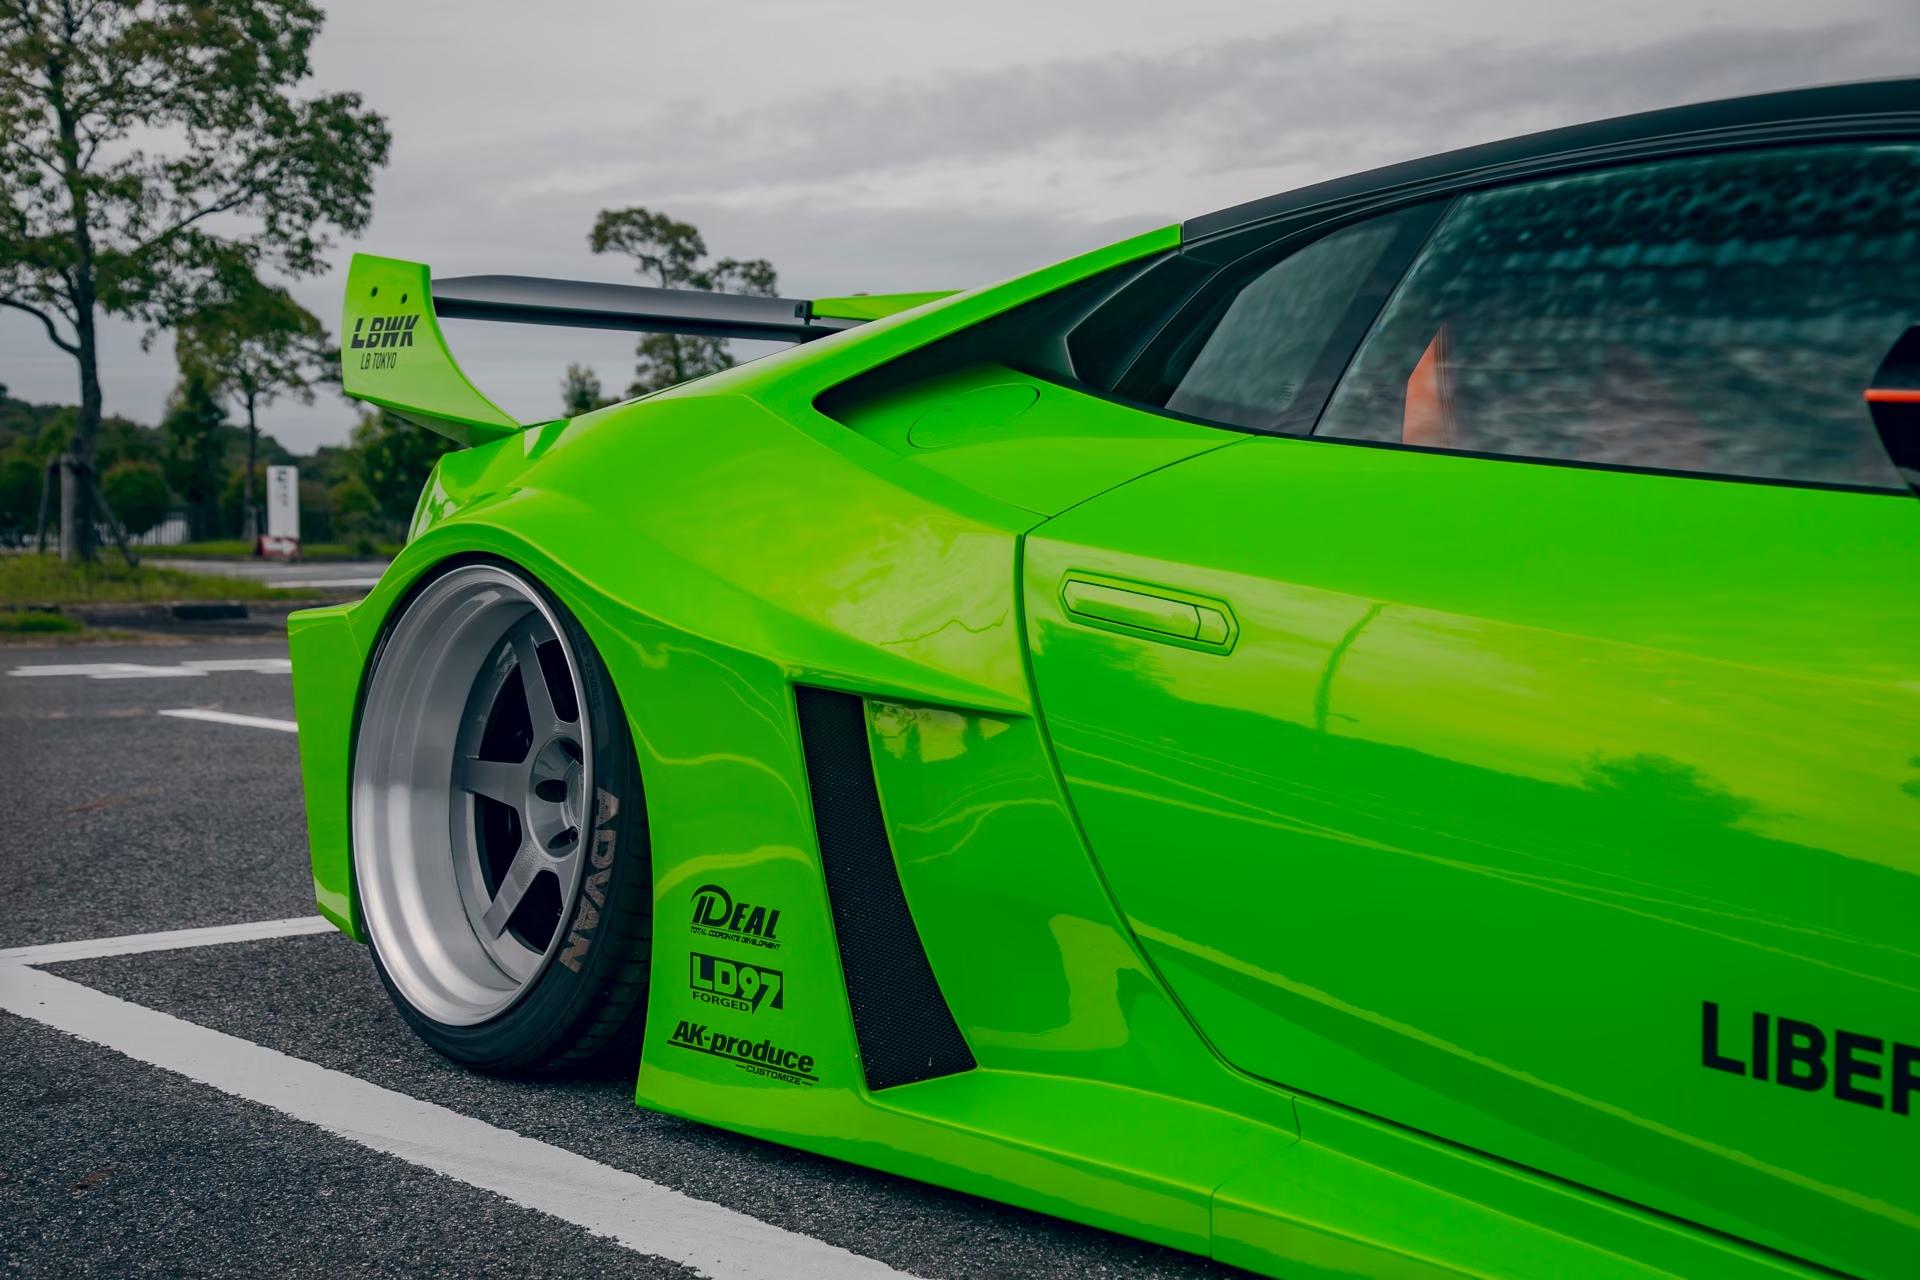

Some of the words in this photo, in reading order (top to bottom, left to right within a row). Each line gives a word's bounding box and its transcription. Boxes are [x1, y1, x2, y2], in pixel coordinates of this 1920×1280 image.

[351, 315, 420, 349] LBWK
[360, 353, 371, 370] LB
[372, 352, 398, 370] TOKYO
[558, 786, 619, 974] ADVAN
[690, 884, 781, 940] IDEAL
[690, 926, 707, 936] TOTAL
[741, 937, 781, 951] DEVELOPMENT
[691, 953, 783, 1013] LD97
[692, 991, 750, 1012] FORGED
[672, 1020, 815, 1073] AK-produce
[746, 1065, 802, 1086] CUSTOMIZE
